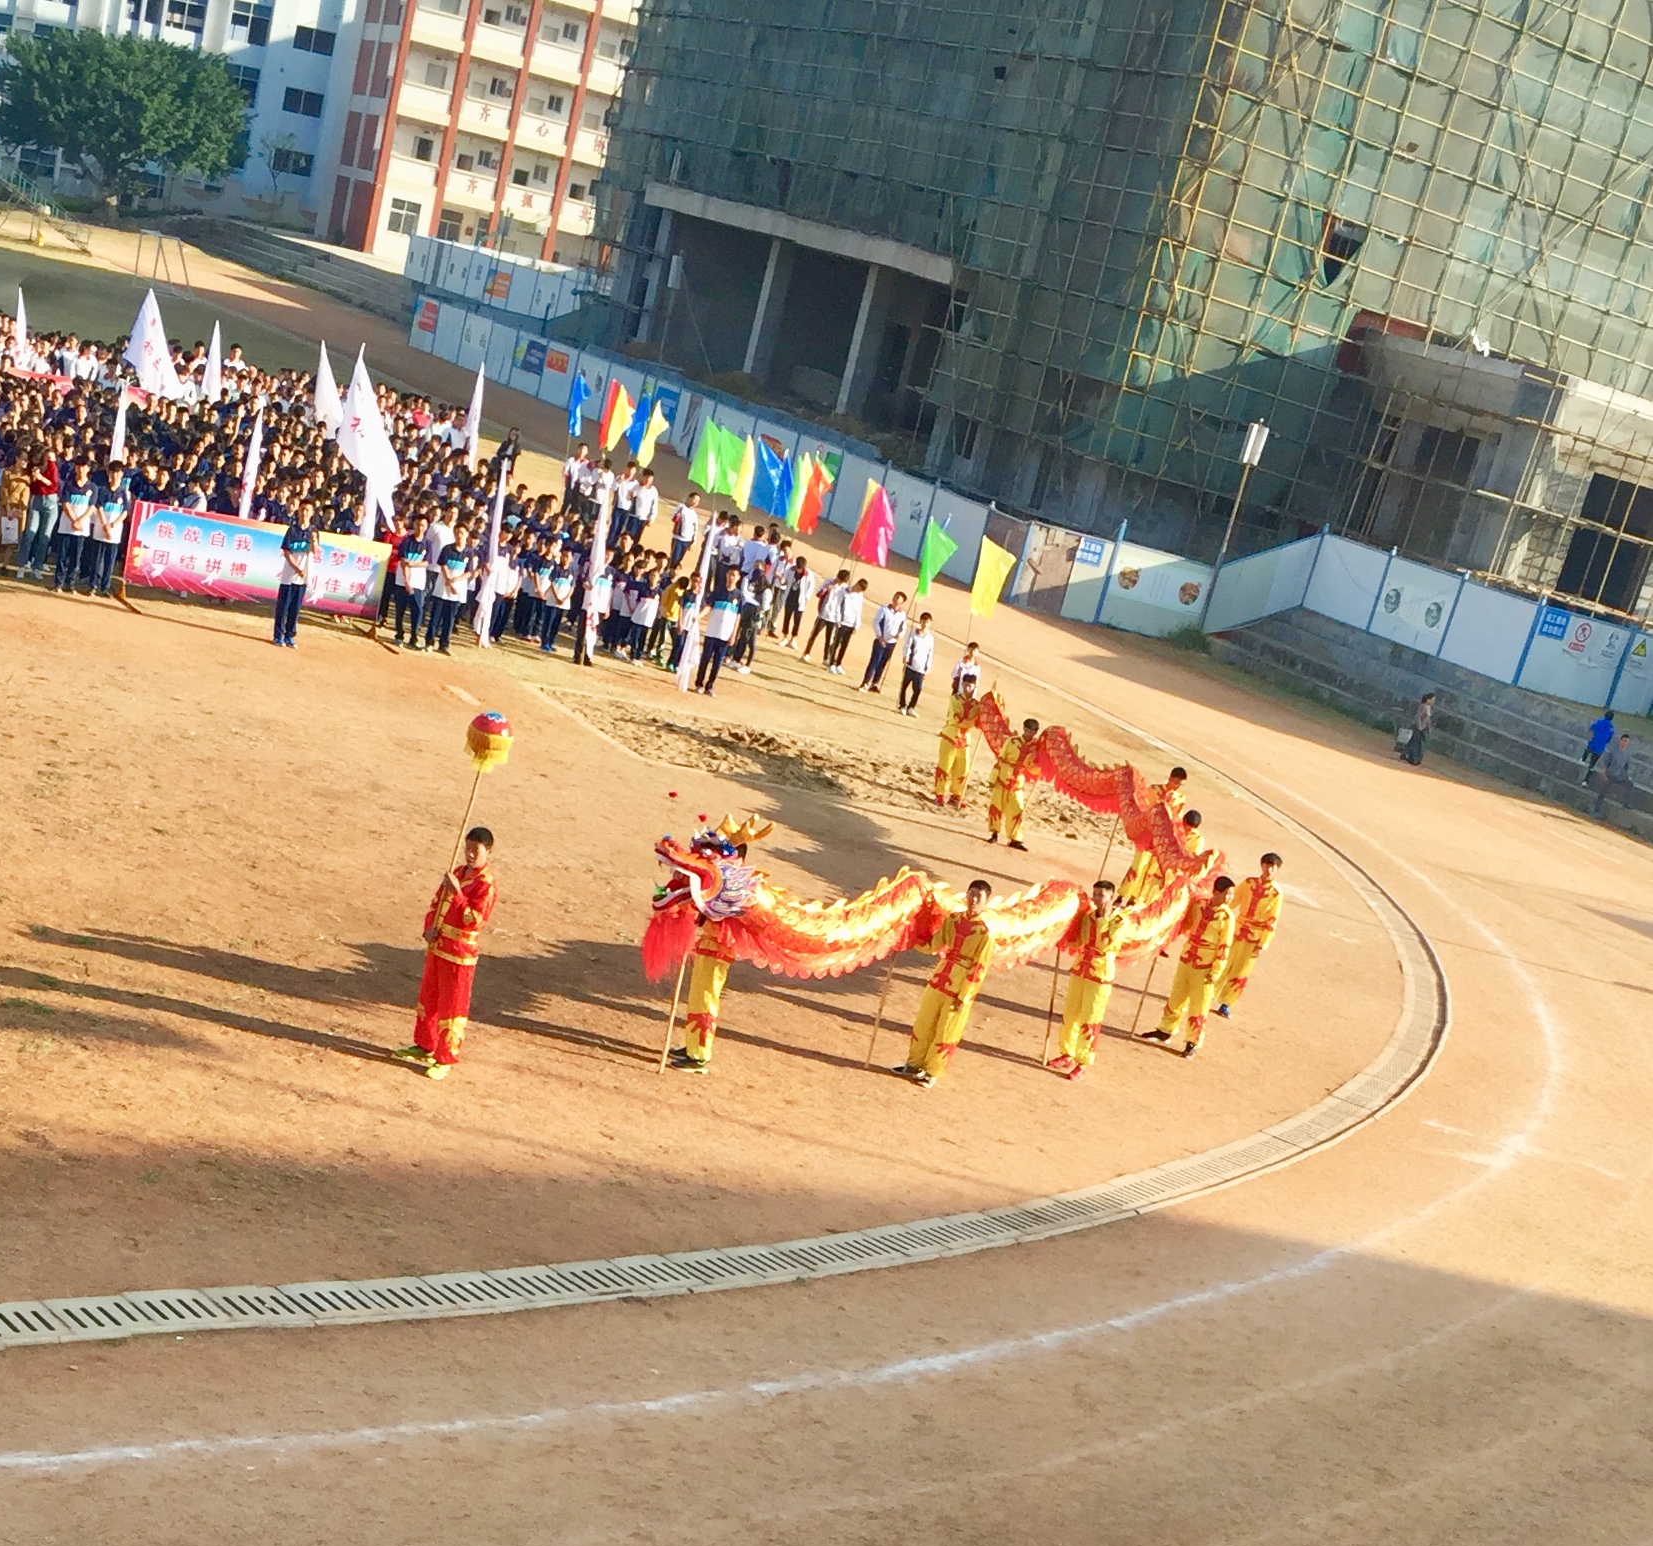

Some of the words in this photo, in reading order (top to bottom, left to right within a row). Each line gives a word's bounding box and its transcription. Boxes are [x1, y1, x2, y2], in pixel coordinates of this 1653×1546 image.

[157, 522, 252, 551] 挑战自我
[152, 549, 248, 577] 团结拼搏
